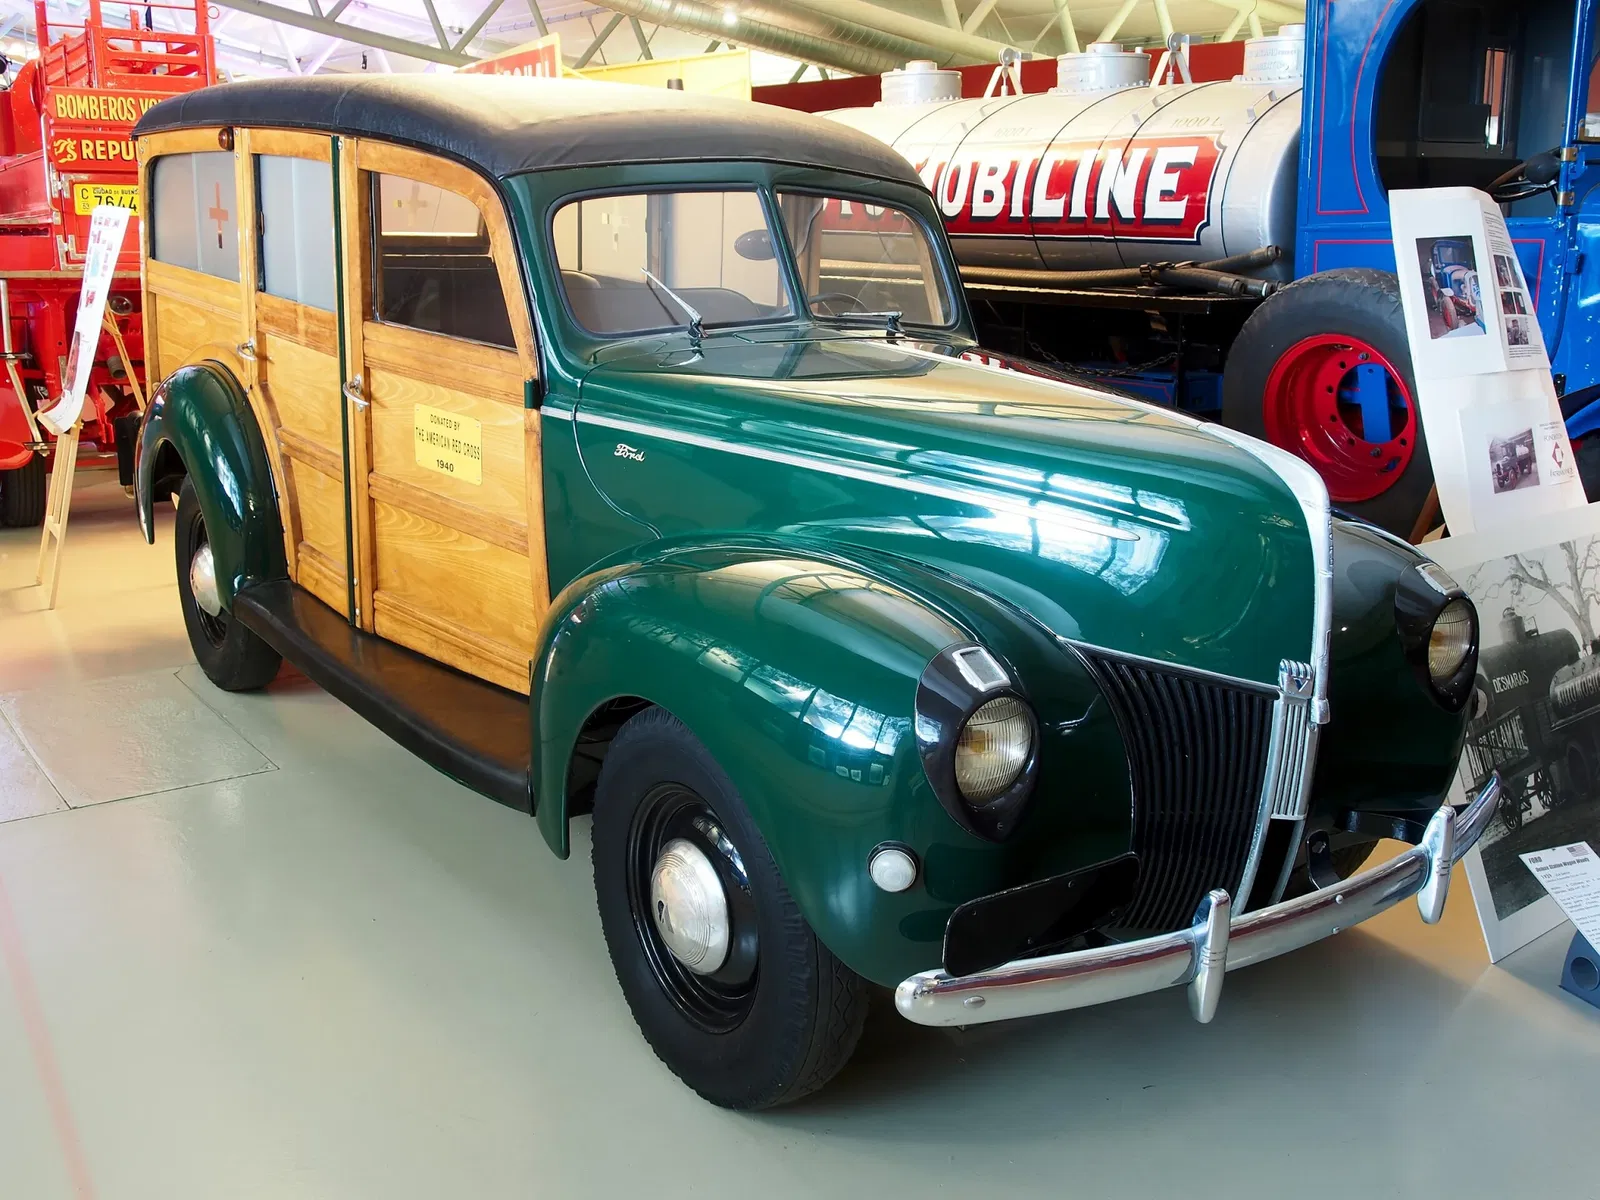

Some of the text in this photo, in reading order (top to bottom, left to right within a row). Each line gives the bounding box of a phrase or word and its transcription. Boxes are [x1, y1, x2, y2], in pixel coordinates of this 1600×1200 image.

[55, 94, 137, 121] BOMBEROS
[81, 139, 138, 161] REPU
[81, 188, 89, 200] C
[430, 413, 461, 431] DONATED BY
[415, 426, 481, 460] THE AMERICAN RED CROSS
[613, 443, 645, 462] Ford
[436, 459, 455, 473] 1940
[1492, 670, 1529, 692] DESMARAIS
[1528, 856, 1542, 864] FORD
